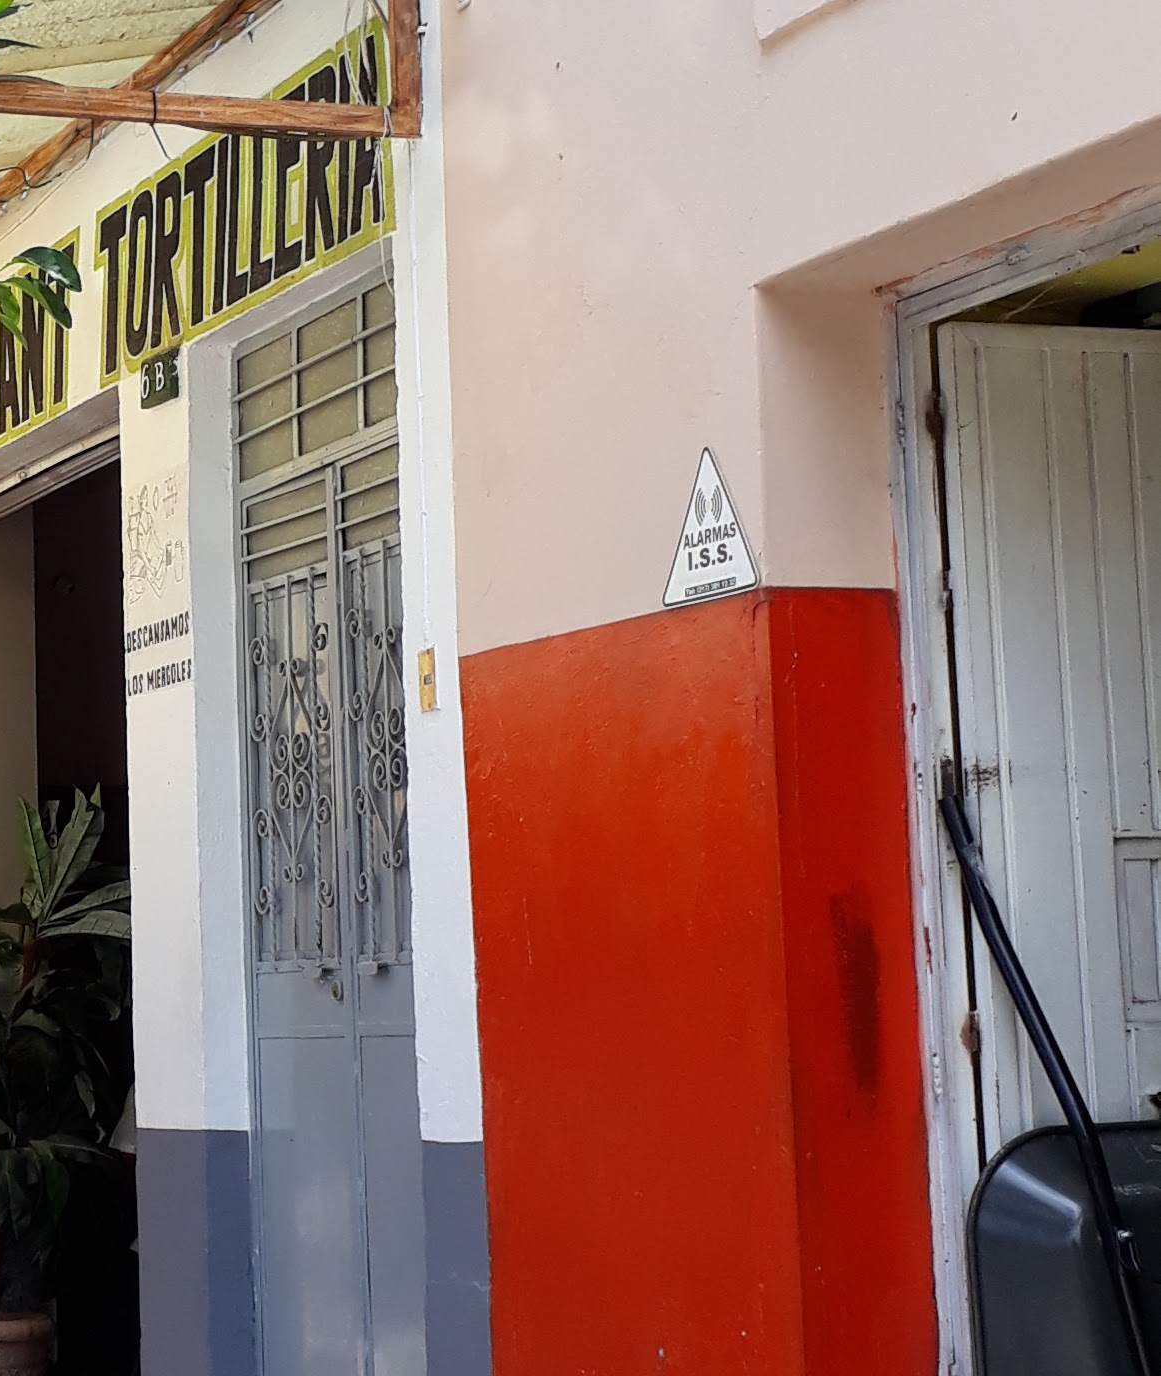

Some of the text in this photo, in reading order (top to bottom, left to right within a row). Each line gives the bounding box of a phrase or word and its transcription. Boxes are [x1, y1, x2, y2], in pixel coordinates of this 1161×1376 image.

[99, 34, 386, 375] TORTILLERIA
[683, 522, 736, 550] ALARMAS
[688, 543, 733, 571] I.S.S.
[126, 611, 189, 653] DESCANSAMOS
[128, 659, 192, 696] LOS MIERCOLES
